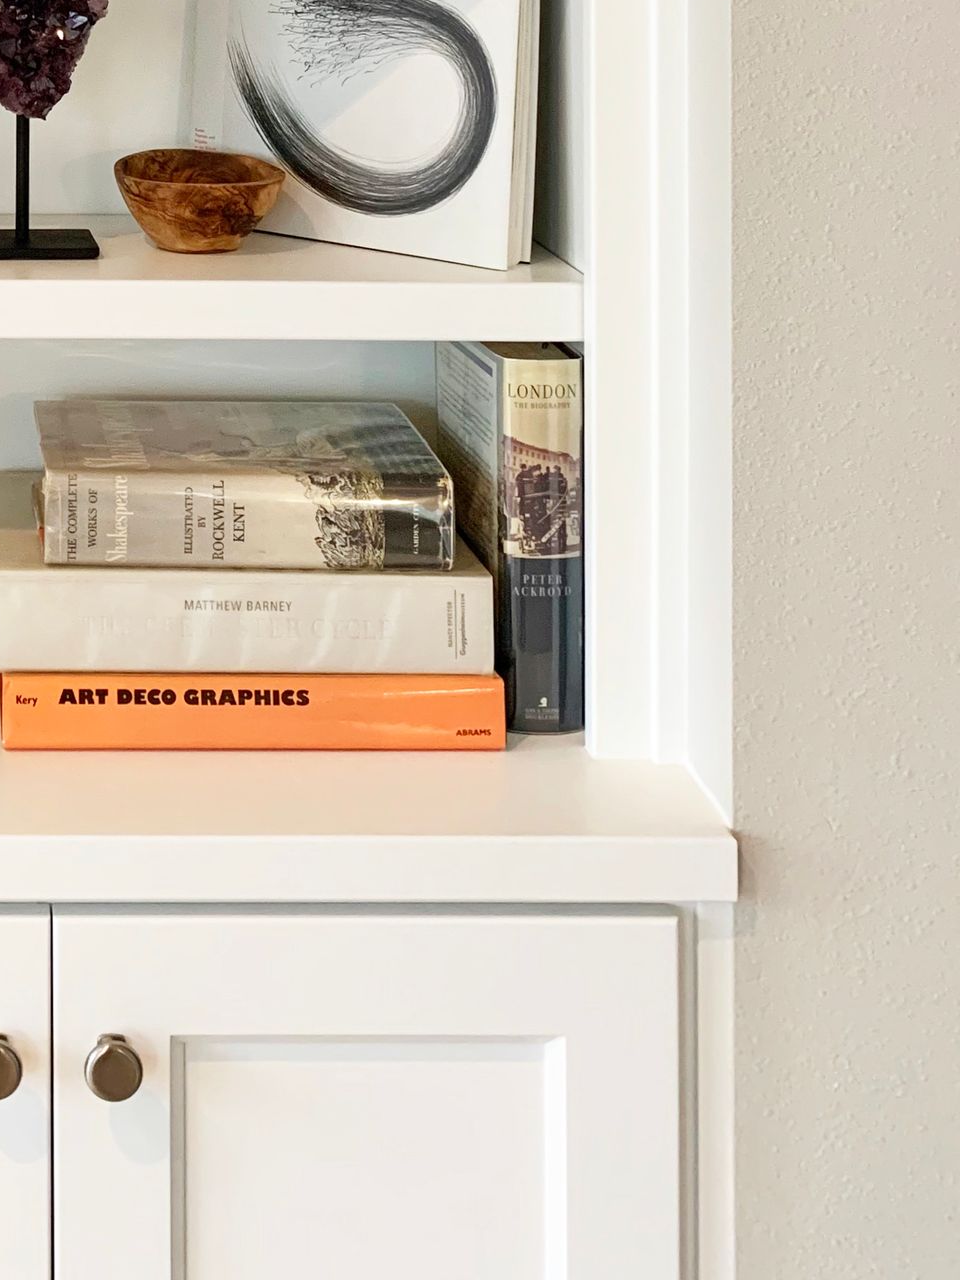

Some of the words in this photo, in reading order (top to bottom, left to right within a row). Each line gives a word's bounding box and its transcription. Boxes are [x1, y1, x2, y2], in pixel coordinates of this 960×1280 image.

[507, 383, 577, 399] LONDON
[67, 474, 77, 534] COMPLETE
[89, 488, 98, 504] OF
[88, 508, 98, 548] WORKS
[105, 475, 134, 562] Shakespeare
[184, 486, 194, 555] ILLUSTRATED
[198, 515, 206, 528] BY
[212, 480, 225, 560] ROCKWELL
[233, 502, 245, 543] KENT
[67, 539, 77, 560] THE
[522, 574, 562, 584] PETER
[183, 599, 243, 612] MATTHEW
[246, 600, 292, 612] BARNEY
[16, 694, 38, 707] Kery
[58, 689, 109, 705] ART
[117, 689, 177, 705] DECO
[183, 689, 310, 706] GRAPHICS
